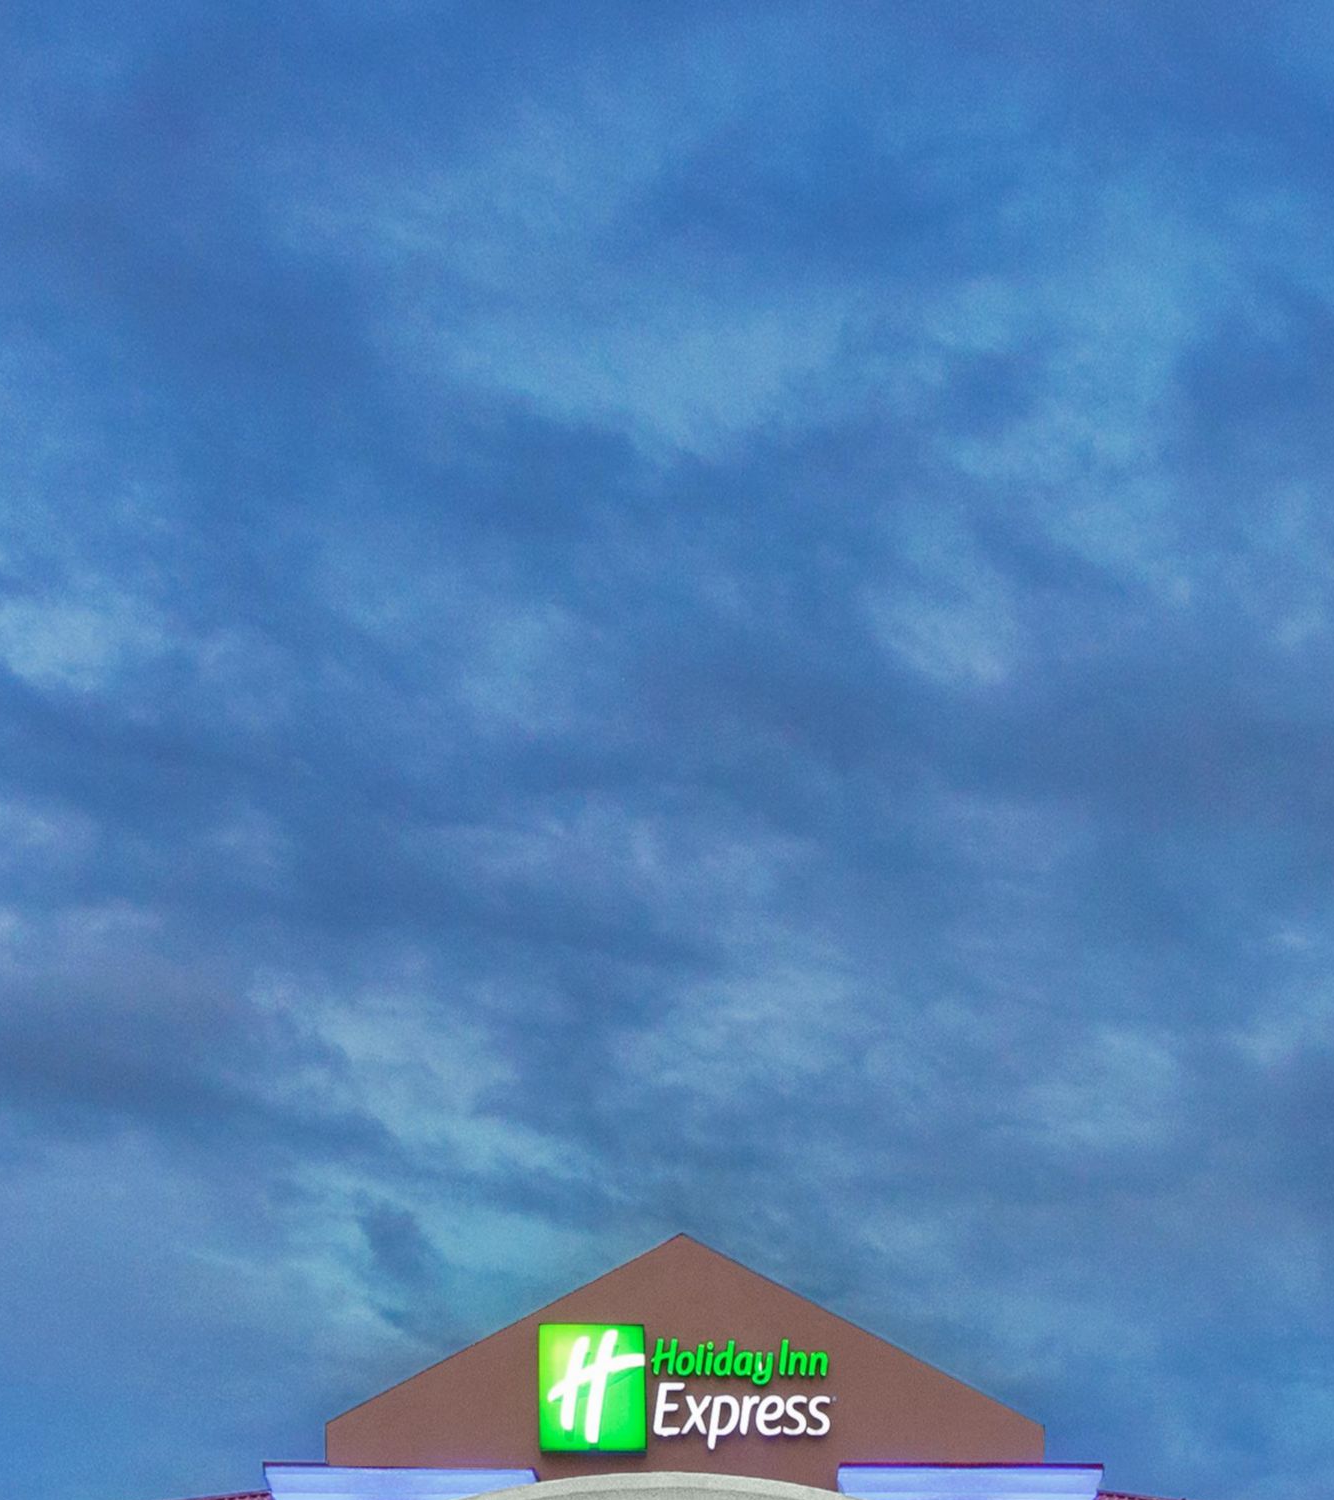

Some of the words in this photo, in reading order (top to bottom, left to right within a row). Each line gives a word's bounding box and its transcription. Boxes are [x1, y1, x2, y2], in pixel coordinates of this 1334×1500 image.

[651, 1337, 775, 1386] Holiday
[778, 1337, 829, 1377] Inn
[652, 1381, 832, 1450] Express
